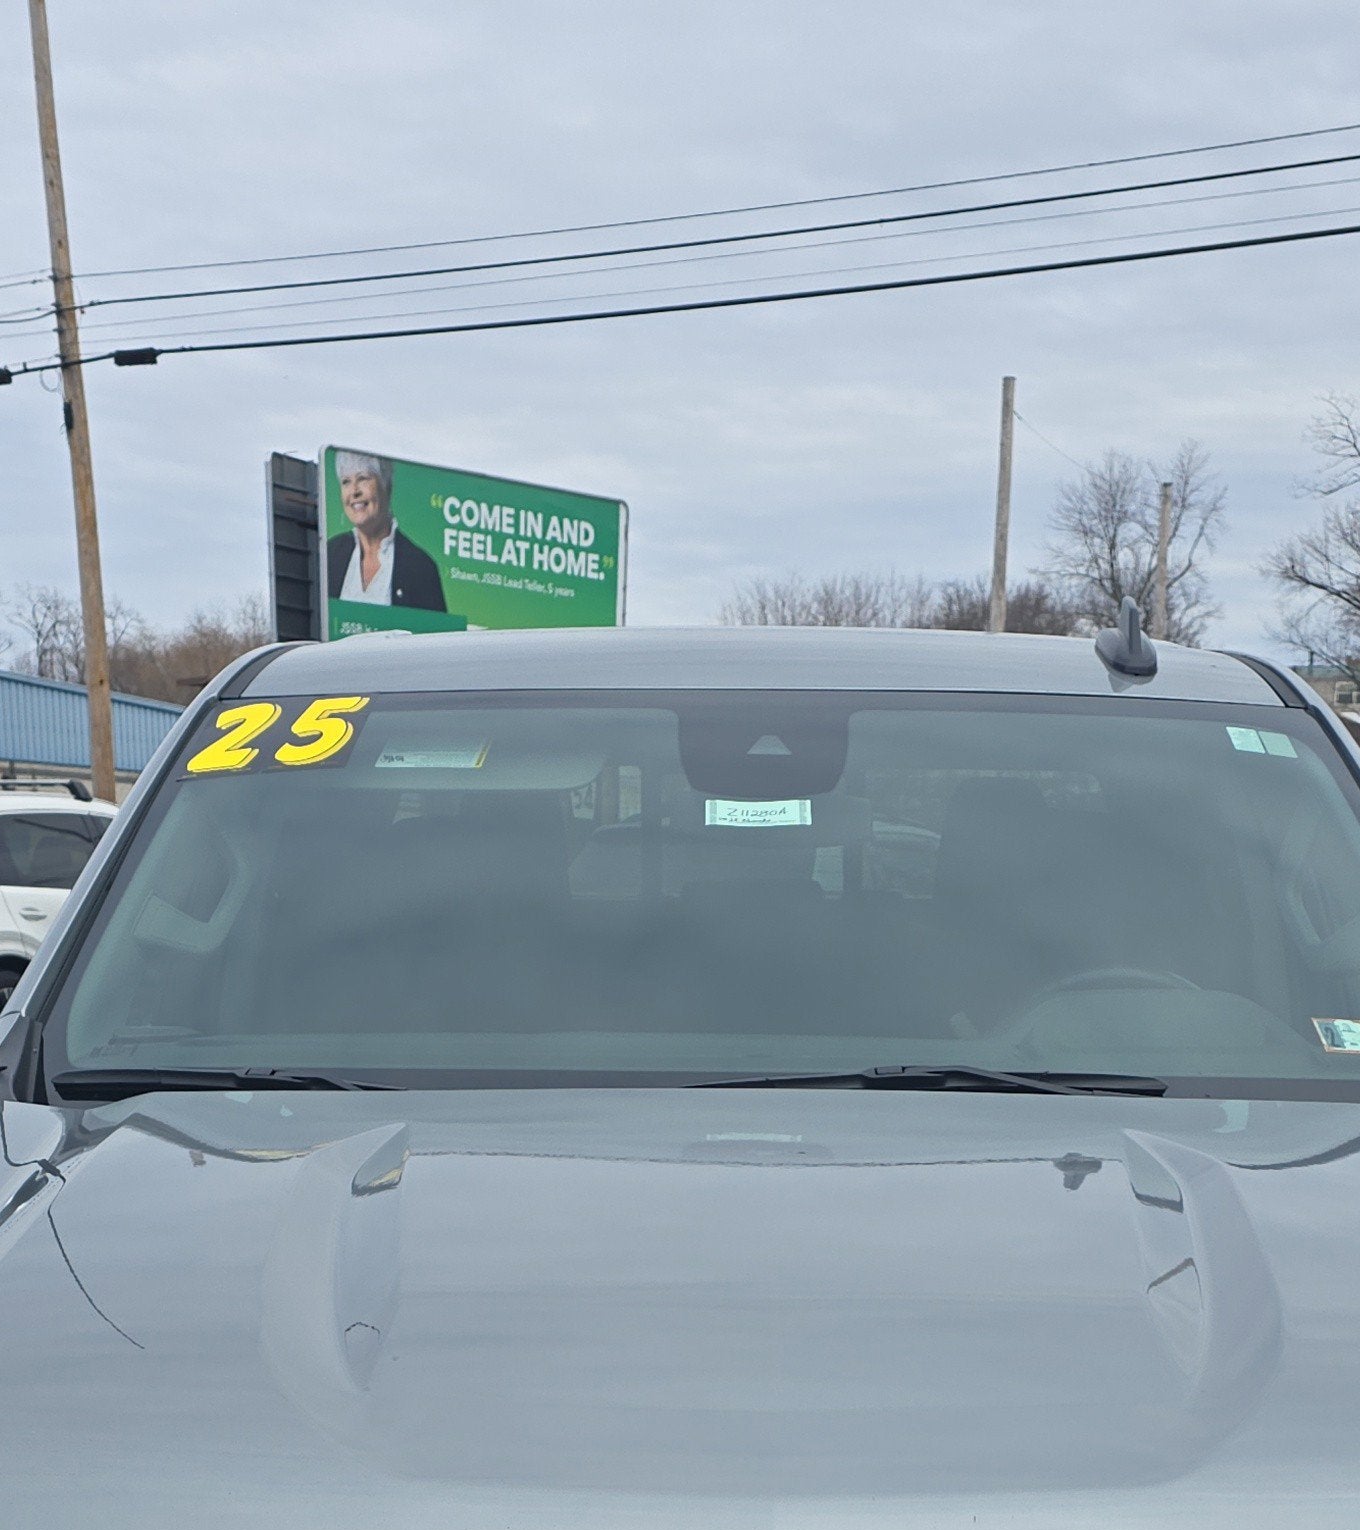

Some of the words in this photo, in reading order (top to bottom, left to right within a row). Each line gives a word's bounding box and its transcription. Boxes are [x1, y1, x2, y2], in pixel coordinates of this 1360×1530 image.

[519, 509, 543, 539] IN
[546, 515, 595, 547] AND
[443, 528, 499, 563] FEEL
[500, 538, 530, 567] AT
[554, 586, 575, 598] years
[187, 696, 370, 773] 25
